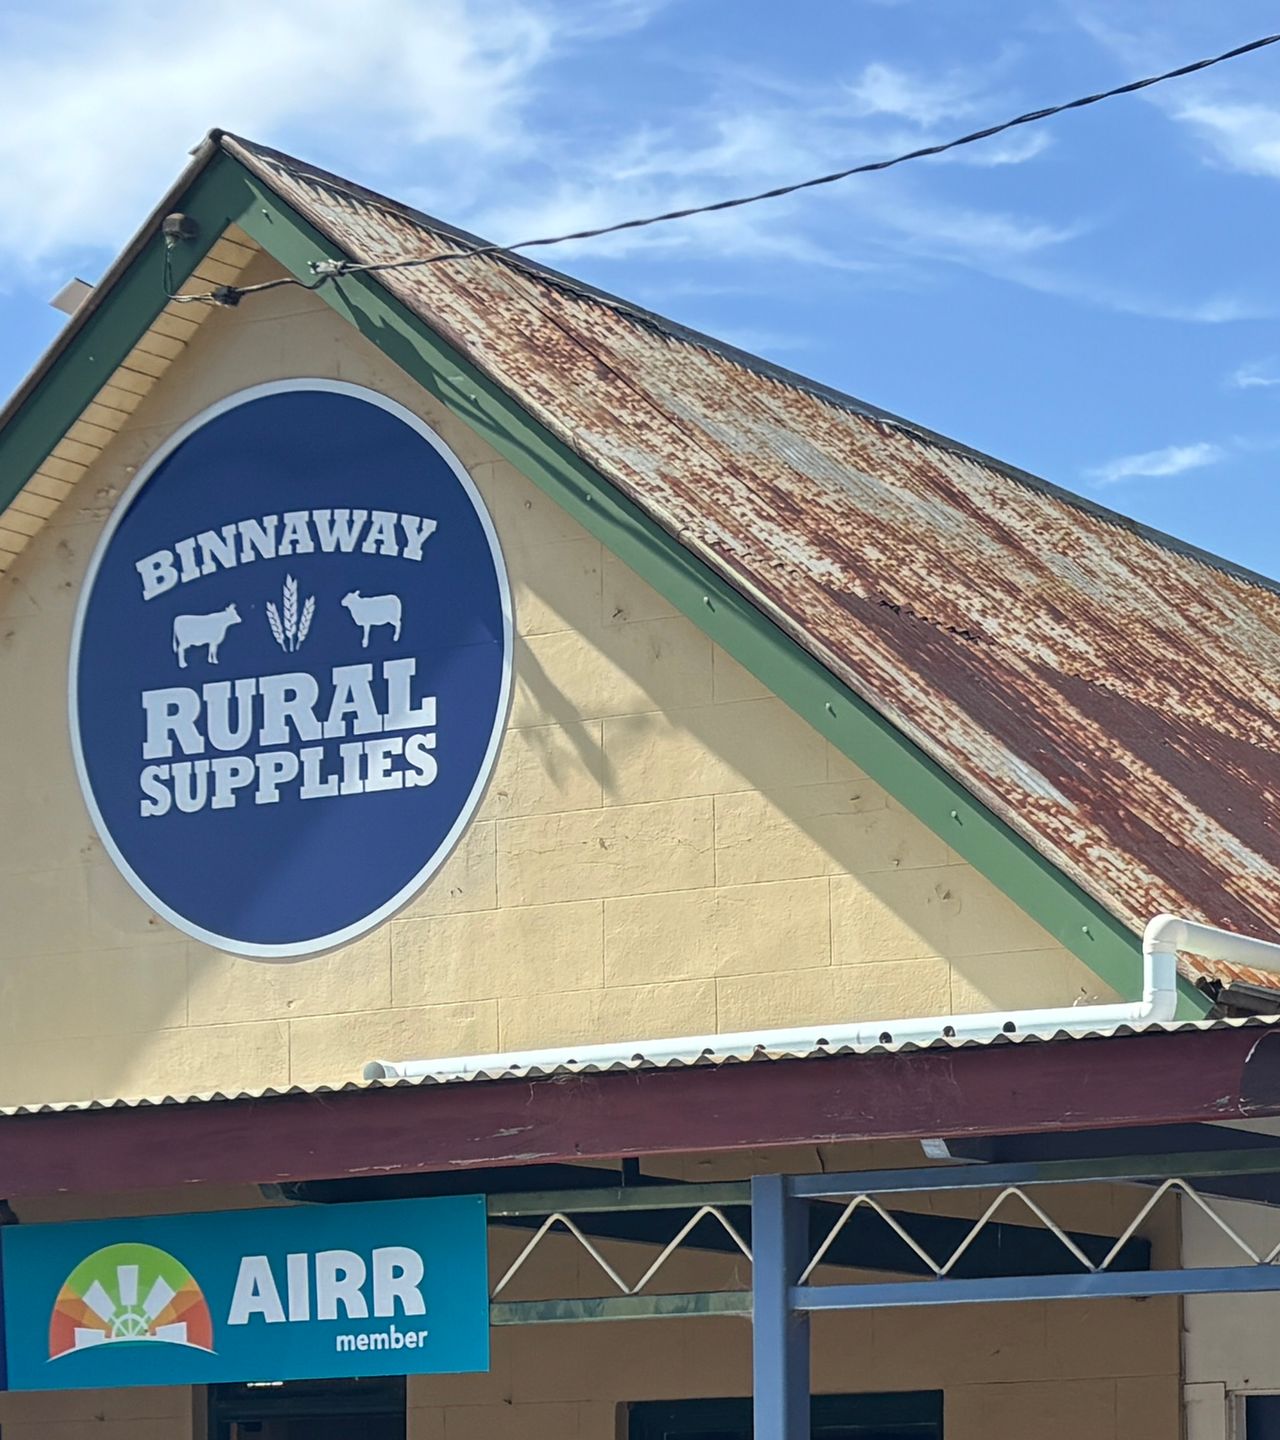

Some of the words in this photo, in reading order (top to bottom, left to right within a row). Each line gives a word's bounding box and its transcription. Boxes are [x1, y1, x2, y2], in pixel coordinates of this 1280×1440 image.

[136, 509, 437, 601] BINNAWAY
[142, 658, 437, 760] RURAL
[140, 734, 438, 817] SUPPLIES
[227, 1246, 426, 1325] AIRR
[336, 1325, 428, 1352] member
